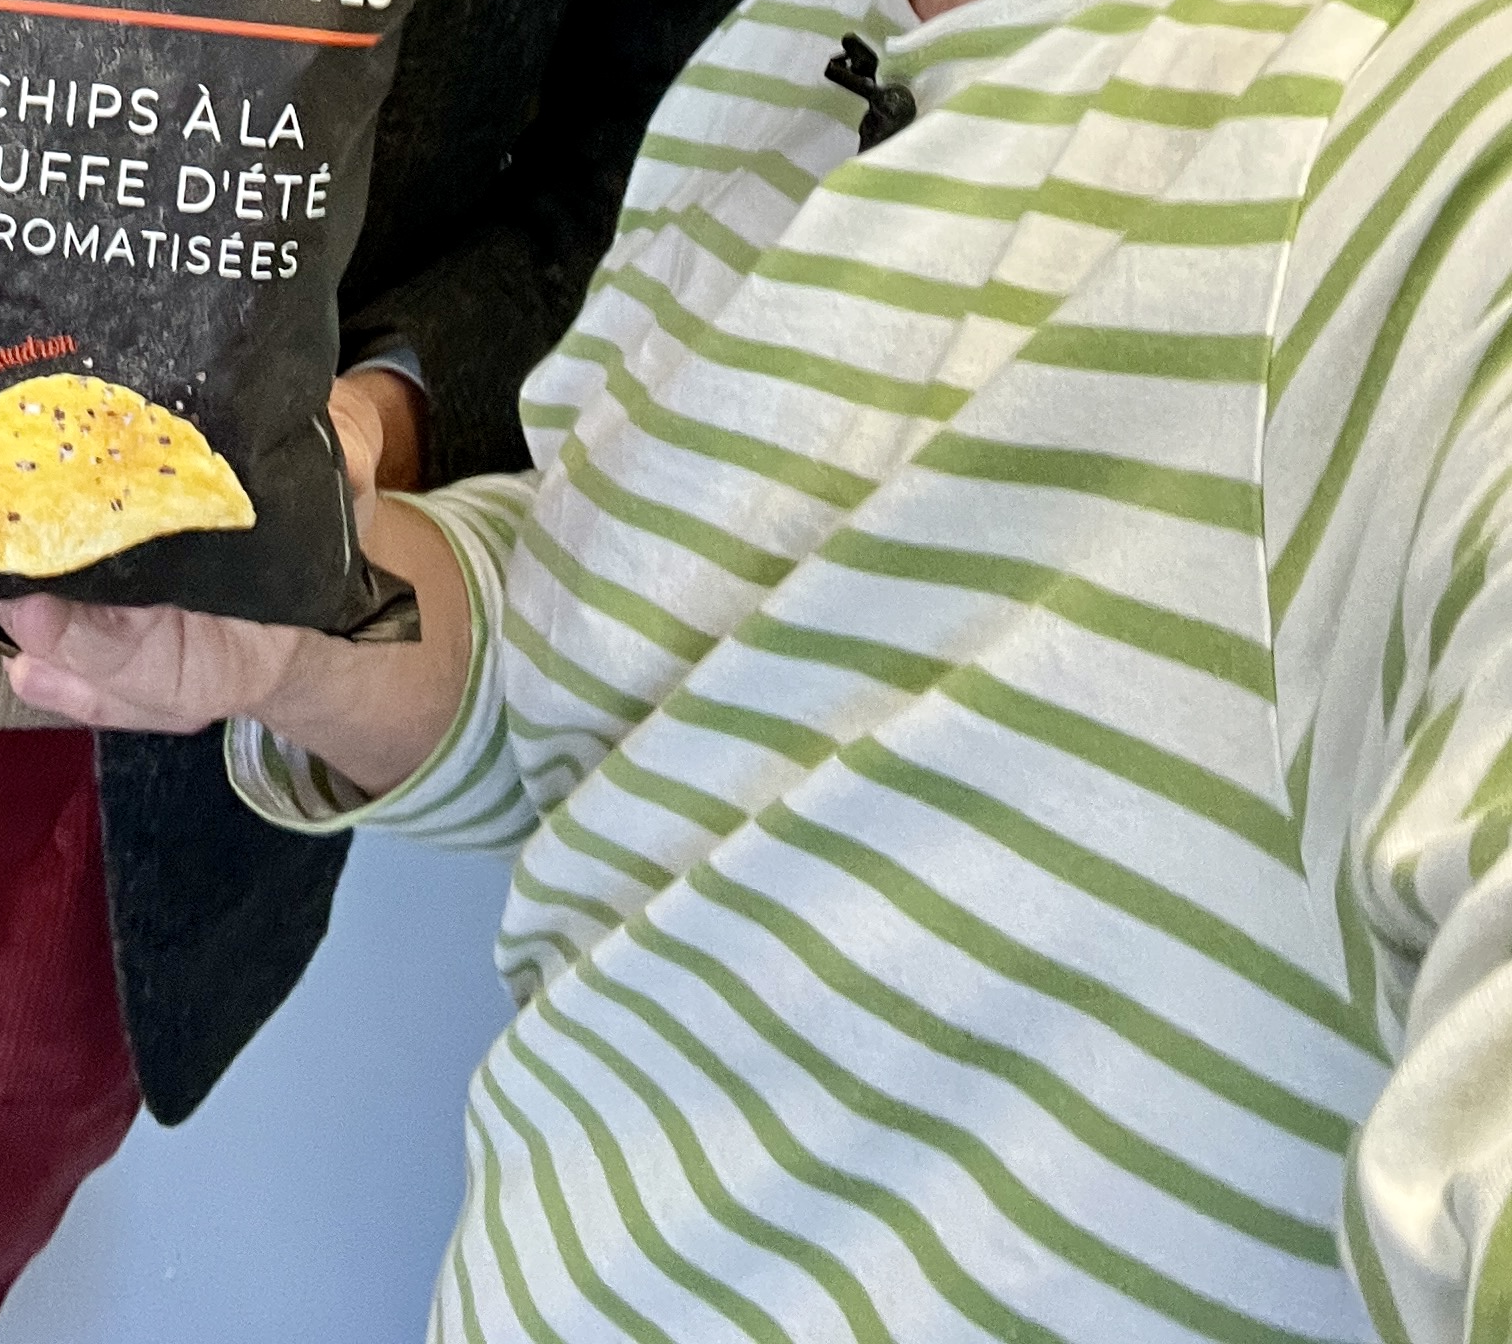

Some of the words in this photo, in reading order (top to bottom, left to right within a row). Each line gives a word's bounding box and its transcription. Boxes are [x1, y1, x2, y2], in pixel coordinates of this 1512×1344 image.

[182, 83, 221, 143] À
[239, 98, 304, 150] LA
[175, 162, 332, 221] D'ÉTÉ
